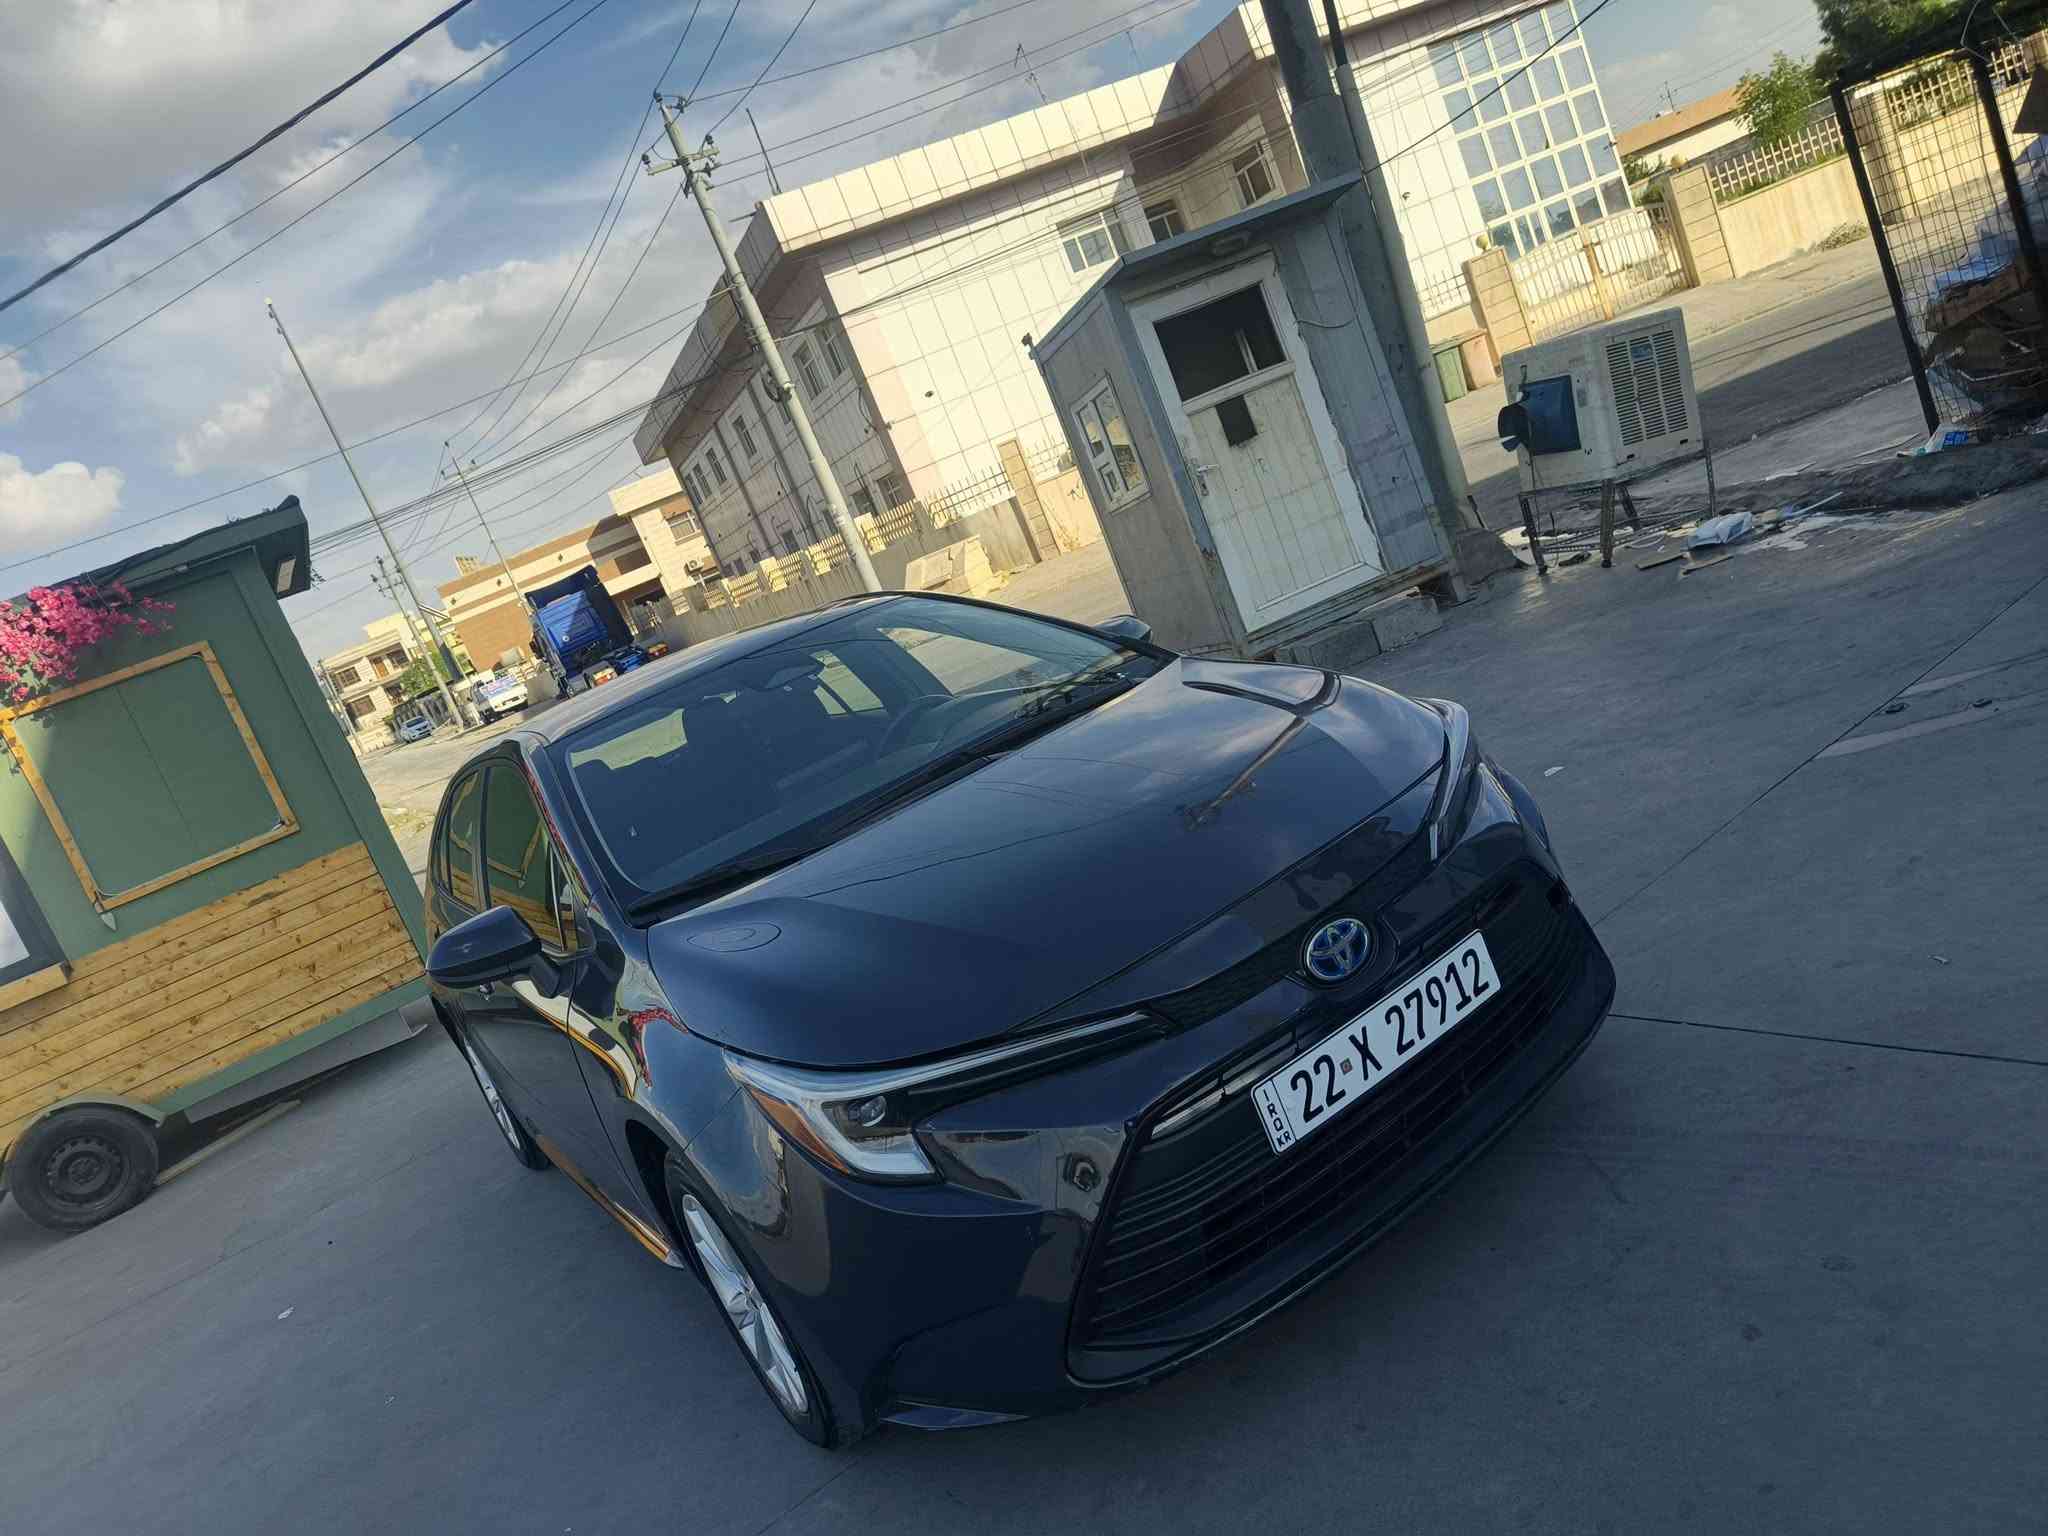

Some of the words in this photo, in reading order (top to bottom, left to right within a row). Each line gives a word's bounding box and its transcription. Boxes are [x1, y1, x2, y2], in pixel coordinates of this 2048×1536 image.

[1290, 1054, 1346, 1123] 22
[1348, 1025, 1383, 1081] X
[1384, 948, 1490, 1056] 27912
[1277, 1131, 1292, 1147] KR
